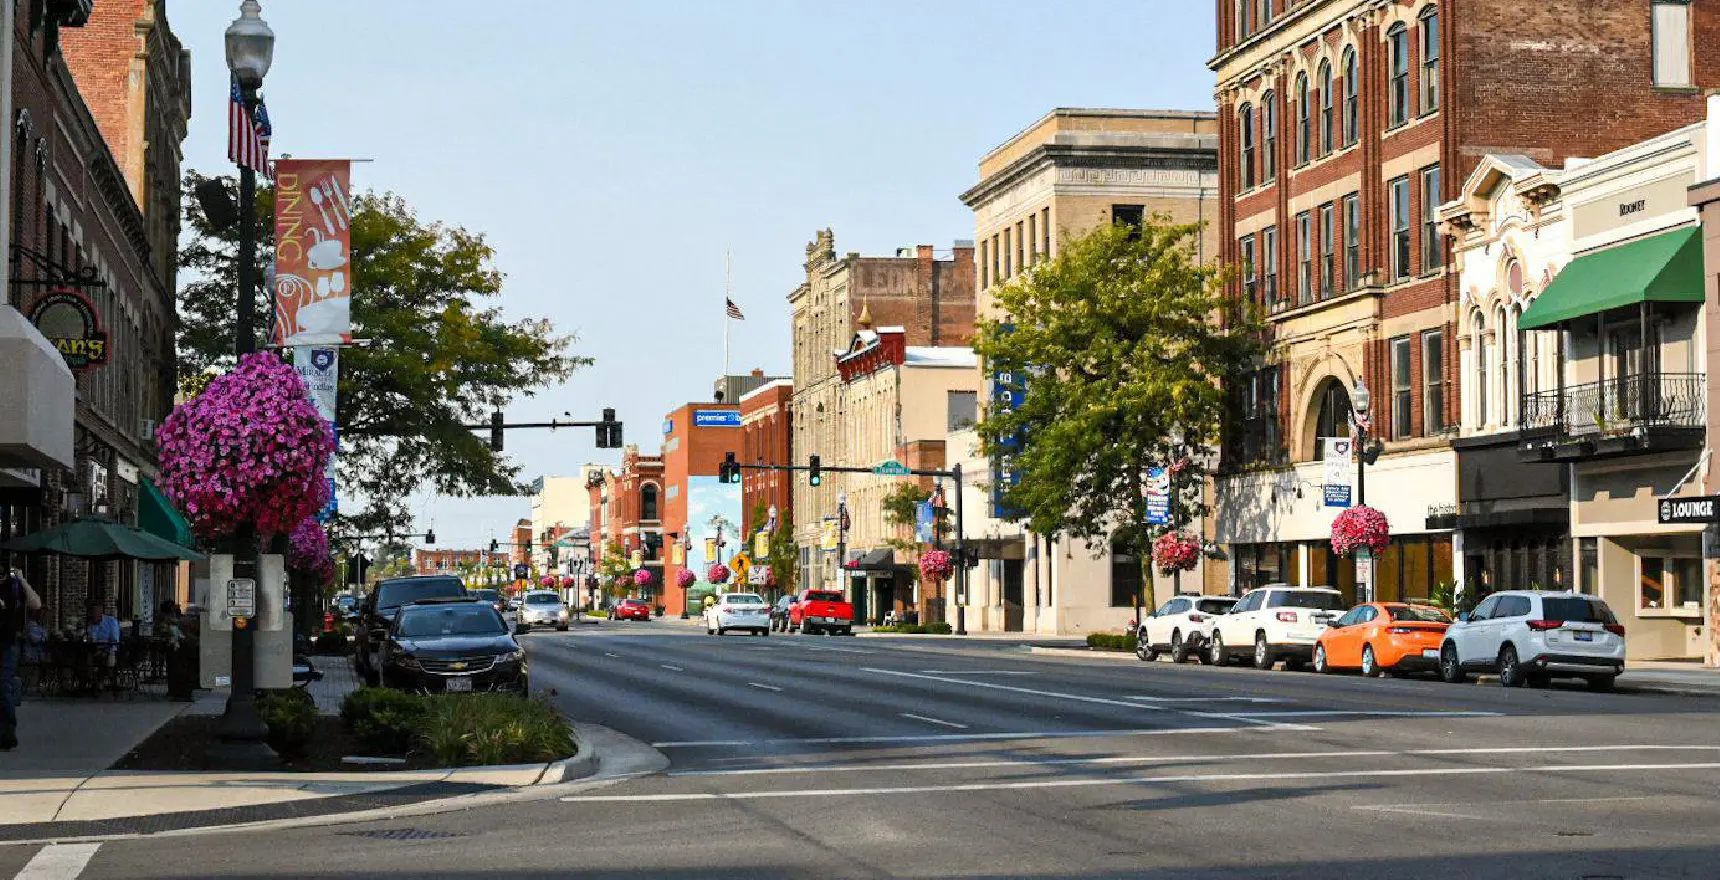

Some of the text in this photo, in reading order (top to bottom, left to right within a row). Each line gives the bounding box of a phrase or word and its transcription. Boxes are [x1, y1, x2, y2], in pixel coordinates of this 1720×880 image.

[277, 173, 303, 261] DINING
[696, 413, 728, 423] premier
[1671, 500, 1713, 519] LOUNGE
